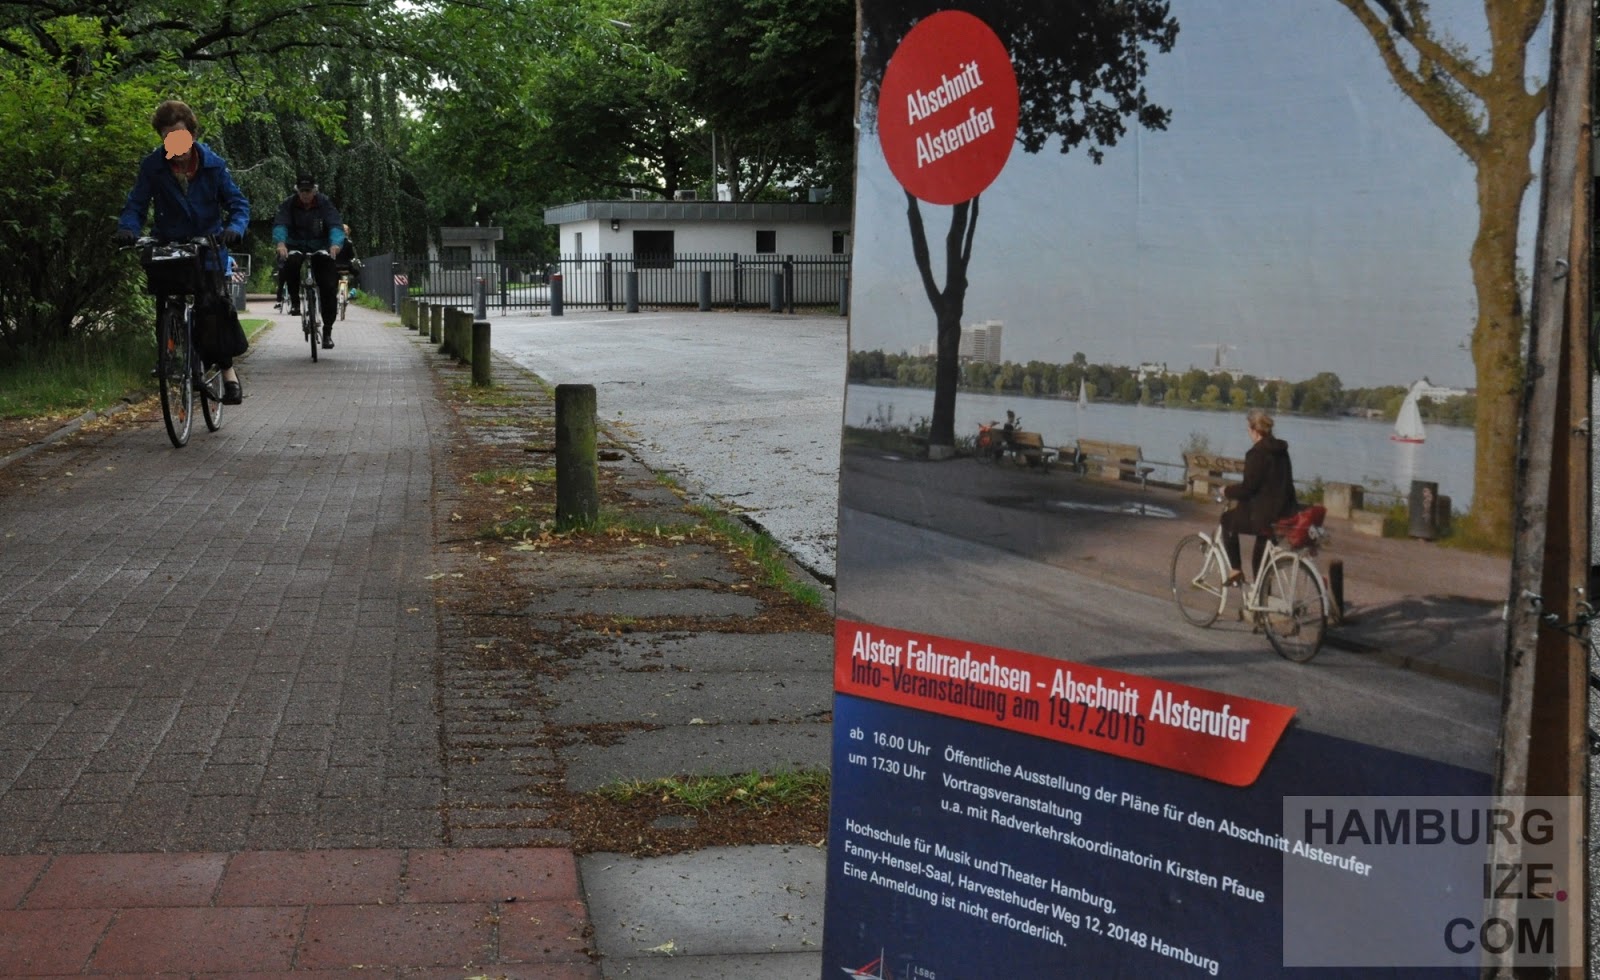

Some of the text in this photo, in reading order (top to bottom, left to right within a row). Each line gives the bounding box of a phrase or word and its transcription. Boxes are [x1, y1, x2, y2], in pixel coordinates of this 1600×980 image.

[907, 60, 983, 125] Abschnitt
[916, 106, 995, 169] Alsterufer
[851, 655, 1146, 746] Info-Veranstaltung am 19.7.2016
[853, 631, 902, 667] Alster
[907, 640, 1031, 693] Fahrradachsen
[1050, 668, 1139, 717] Abschnitt
[1149, 689, 1250, 742] Alsterufer
[849, 752, 1082, 825] um 17.30 Uhr Vortragsveranstaltung
[849, 727, 1372, 877] ab 16.00 Uhr Öffentliche Ausstellung der Pläne für den Abschnitt Alsterufer
[845, 818, 1117, 914] Hochschule für Musik und Theater Hamburg,
[941, 800, 1265, 903] u.a. mit Radverkehrskoordinatorin Kirsten Pfaue
[843, 862, 1067, 947] Eine Anmeldung ist nicht erforderlich.
[845, 840, 1219, 976] Fanny-Hensel-Saal, Harvestehuder Weg 12, 20148 Hamburg
[914, 966, 936, 980] LSBG
